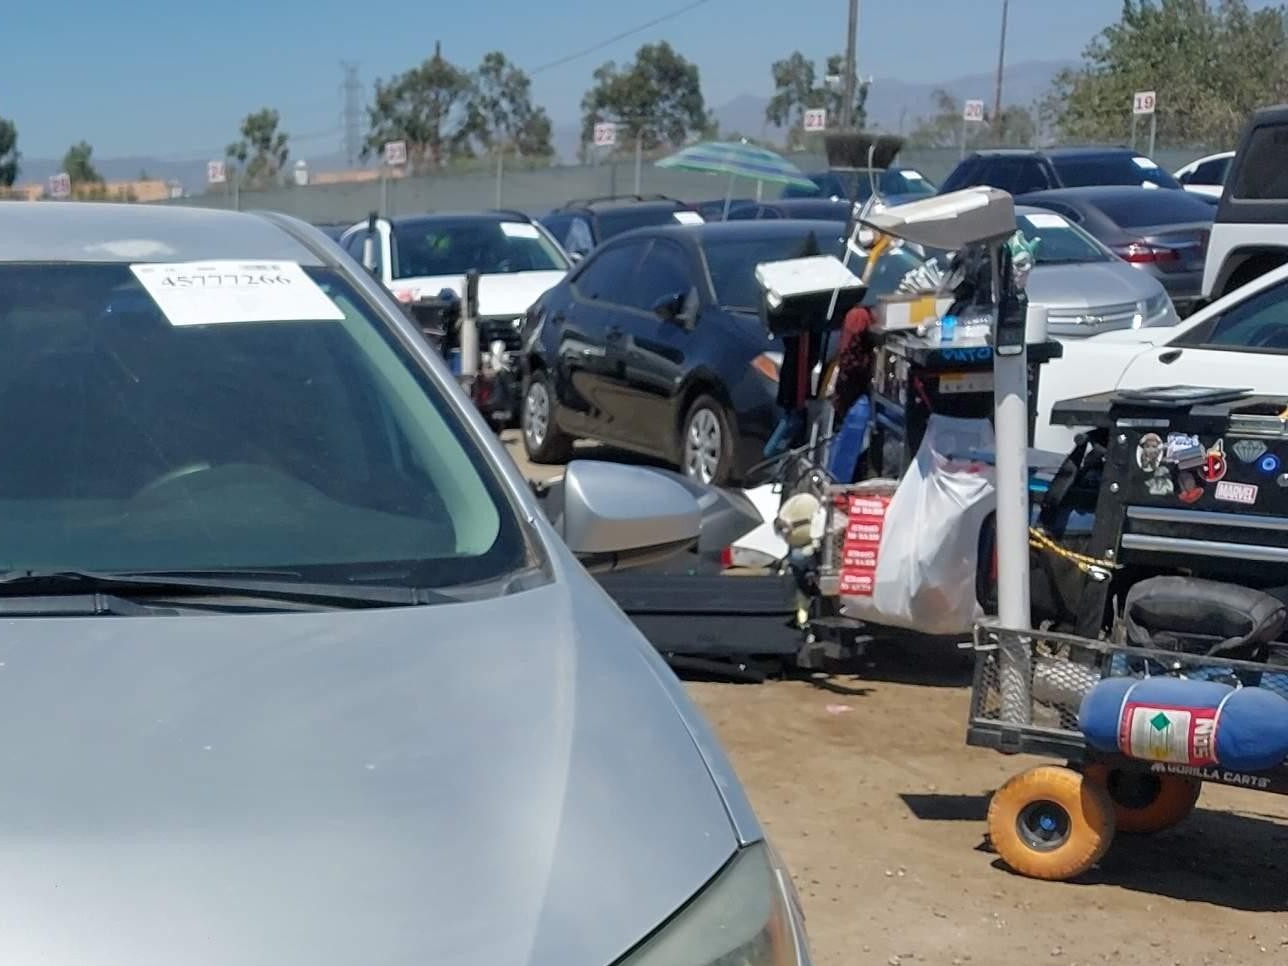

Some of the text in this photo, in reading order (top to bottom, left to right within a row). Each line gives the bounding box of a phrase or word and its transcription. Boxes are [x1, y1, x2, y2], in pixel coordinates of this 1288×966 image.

[966, 102, 982, 118] 20
[1135, 95, 1154, 110] 19
[807, 112, 823, 128] 21
[161, 274, 292, 288] 45777266
[1216, 482, 1256, 502] MARVEL
